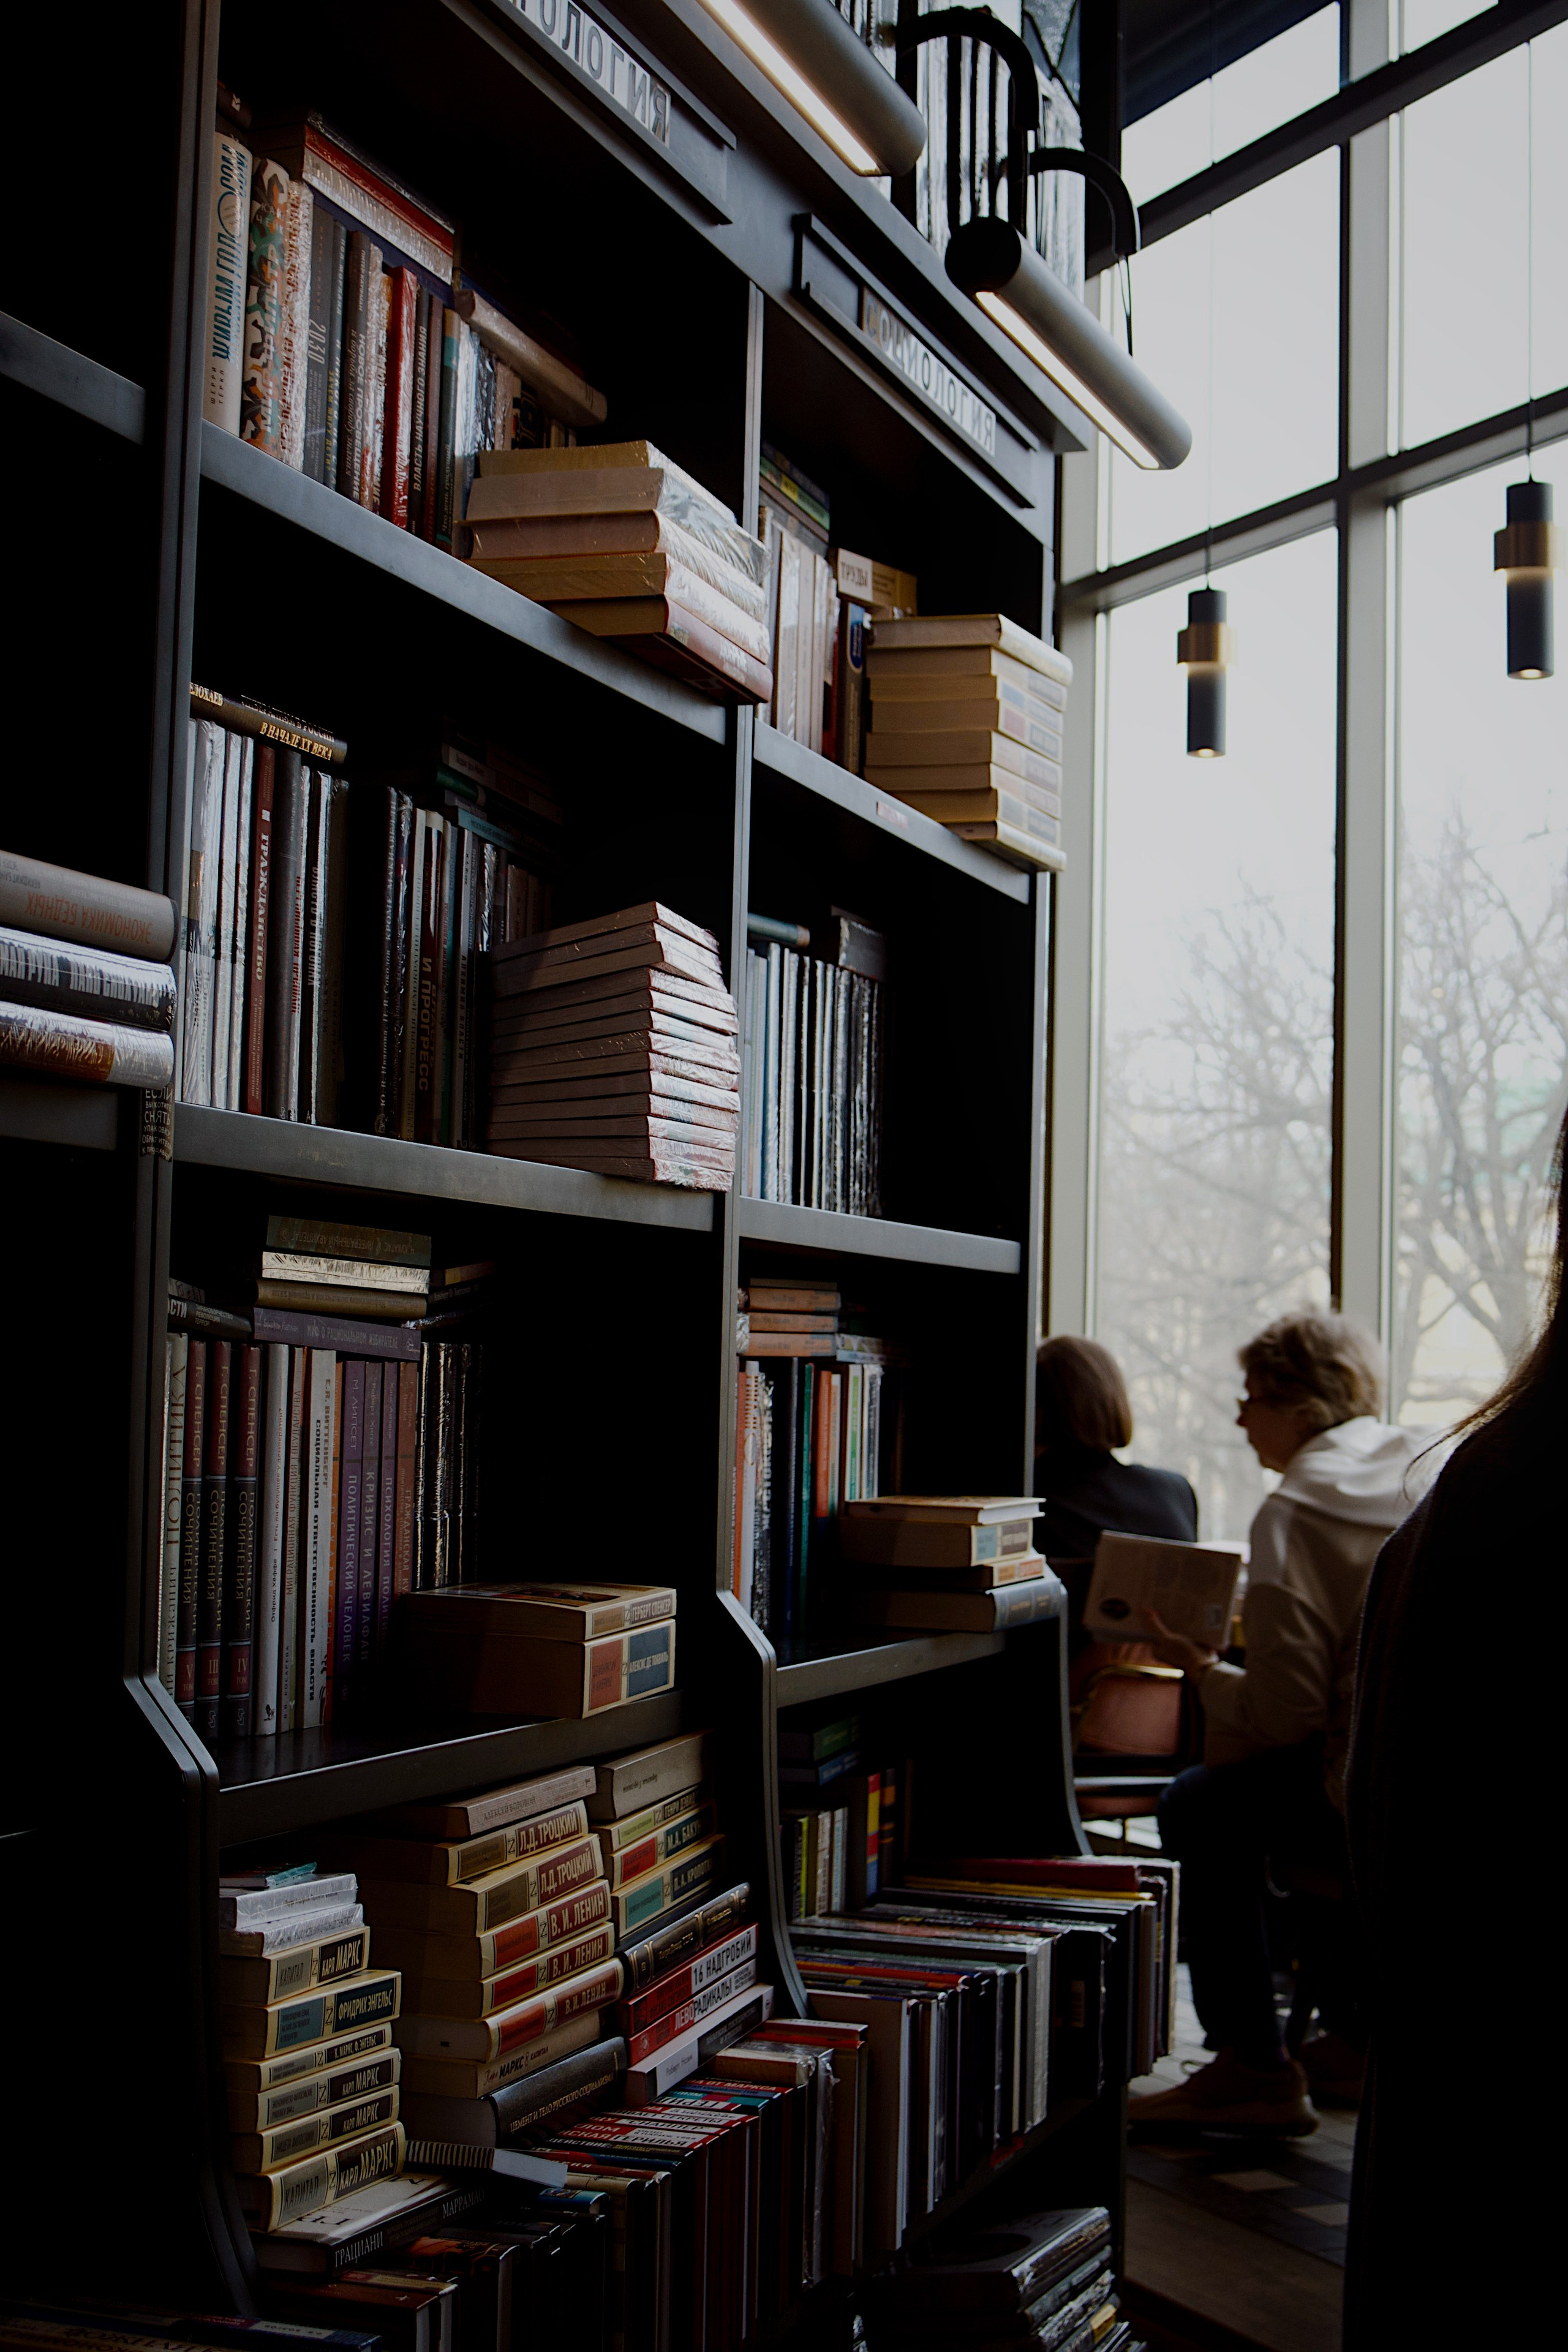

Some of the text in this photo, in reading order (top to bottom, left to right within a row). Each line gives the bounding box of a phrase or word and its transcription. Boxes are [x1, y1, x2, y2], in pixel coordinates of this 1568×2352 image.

[514, 0, 666, 143] ОЛОГИЯ
[213, 274, 233, 361] ЖИВЫМ
[308, 318, 326, 364] 2030
[866, 297, 993, 453] СОЦИОЛОГИЯ
[344, 393, 355, 432] свободу
[413, 326, 428, 491] ВЛАСТЬ НАУЧНОГО ЗНАНИЯ
[353, 387, 364, 502] ПРОСВЕЩЕНИЕ
[189, 682, 224, 706] ЕЛОХАЕВ
[260, 722, 268, 735] В
[266, 723, 301, 749] НАЧАЛЕ
[311, 741, 333, 761] ВЕКА
[24, 891, 153, 944] ЭКОНОМИКА БЕДНЫХ
[255, 833, 270, 980] ГРАЖДАНСТВО
[418, 957, 432, 1091] И ПРОГРЕСС
[144, 1110, 170, 1125] СНЯТЬ
[145, 1087, 173, 1102] ЕСЛИ
[291, 1231, 328, 1246] АРХИПЕЛАГ
[328, 1236, 374, 1251] ЛИБЕРАЛЬНЫЙ
[307, 1324, 320, 1337] МИФ
[326, 1329, 367, 1344] РАЦИОНАЛЬНОМ
[352, 1379, 358, 1392] М.
[193, 1366, 203, 1467] Г. СПЕНСЕР
[217, 1366, 228, 1465] Г. СПЕНСЕР
[246, 1369, 257, 1467] Г. СПЕНСЕР
[290, 1390, 301, 1460] ГОСУДАРСТВА
[166, 1365, 186, 1545] ПОЛИТИКА
[289, 1464, 298, 1512] ФУНКЦИЯ
[183, 1492, 194, 1604] СОЧИНЕНИЯ
[206, 1490, 219, 1599] СОЧИНЕНИЯ
[235, 1491, 247, 1599] СОЧИНЕНИЯ
[383, 1477, 392, 1567] ПСИХОЛОГИЯ
[402, 1490, 411, 1570] ГРАЖДАНСКАЯ
[192, 1493, 200, 1635] ПОЛИТИЧЕСКИЕ
[216, 1491, 225, 1631] ПОЛИТИЧЕСКИЕ
[244, 1491, 255, 1630] ПОЛИТИЧЕСКИЕ
[285, 1517, 295, 1595] МИГРАЦИОННАЯ
[342, 1475, 356, 1663] ПОЛИТИЧЕСКИЙ ЧЕЛОВЕК
[361, 1472, 374, 1660] КРИЗИС И ЛЕВИАФАН
[186, 1664, 193, 1679] V
[208, 1659, 218, 1674] III
[238, 1658, 248, 1673] IV
[521, 1809, 578, 1853] Л.Д. ТРОЦКИЙ
[541, 1847, 593, 1894] Л.Д. ТРОЦКИЙ
[551, 1891, 605, 1937] В. И. ЛЕНИН
[280, 1939, 361, 1986] КАПИТАЛ КАРЛ МАРКС
[552, 1936, 603, 1978] В. И. ЛЕНИН
[694, 1966, 703, 1986] 16
[706, 1931, 751, 1977] НАДГРОБИЙ
[339, 1989, 393, 2021] ФРИДРИХ ЭНГЕЛЬС
[581, 1982, 606, 2005] ЛЕНИН
[675, 1978, 733, 2031] ЛЕВОРАДИКАЛЫ
[359, 2034, 377, 2050] ЭНГЕЛЬС
[499, 2046, 548, 2079] МАРКС КАПИТАЛ
[342, 2067, 380, 2096] КАРЛ МАРКС
[343, 2102, 380, 2132] КАРЛ МАРКС
[510, 2112, 533, 2135] ЦЕМЕНТ
[539, 2103, 552, 2118] ТЕЛО
[552, 2089, 578, 2113] РУССКОГО
[284, 2139, 394, 2210] КАПИТАЛ КАРЛ МАРКС
[335, 2187, 485, 2267] ГРАЦИАНИ МАРРАМАО
